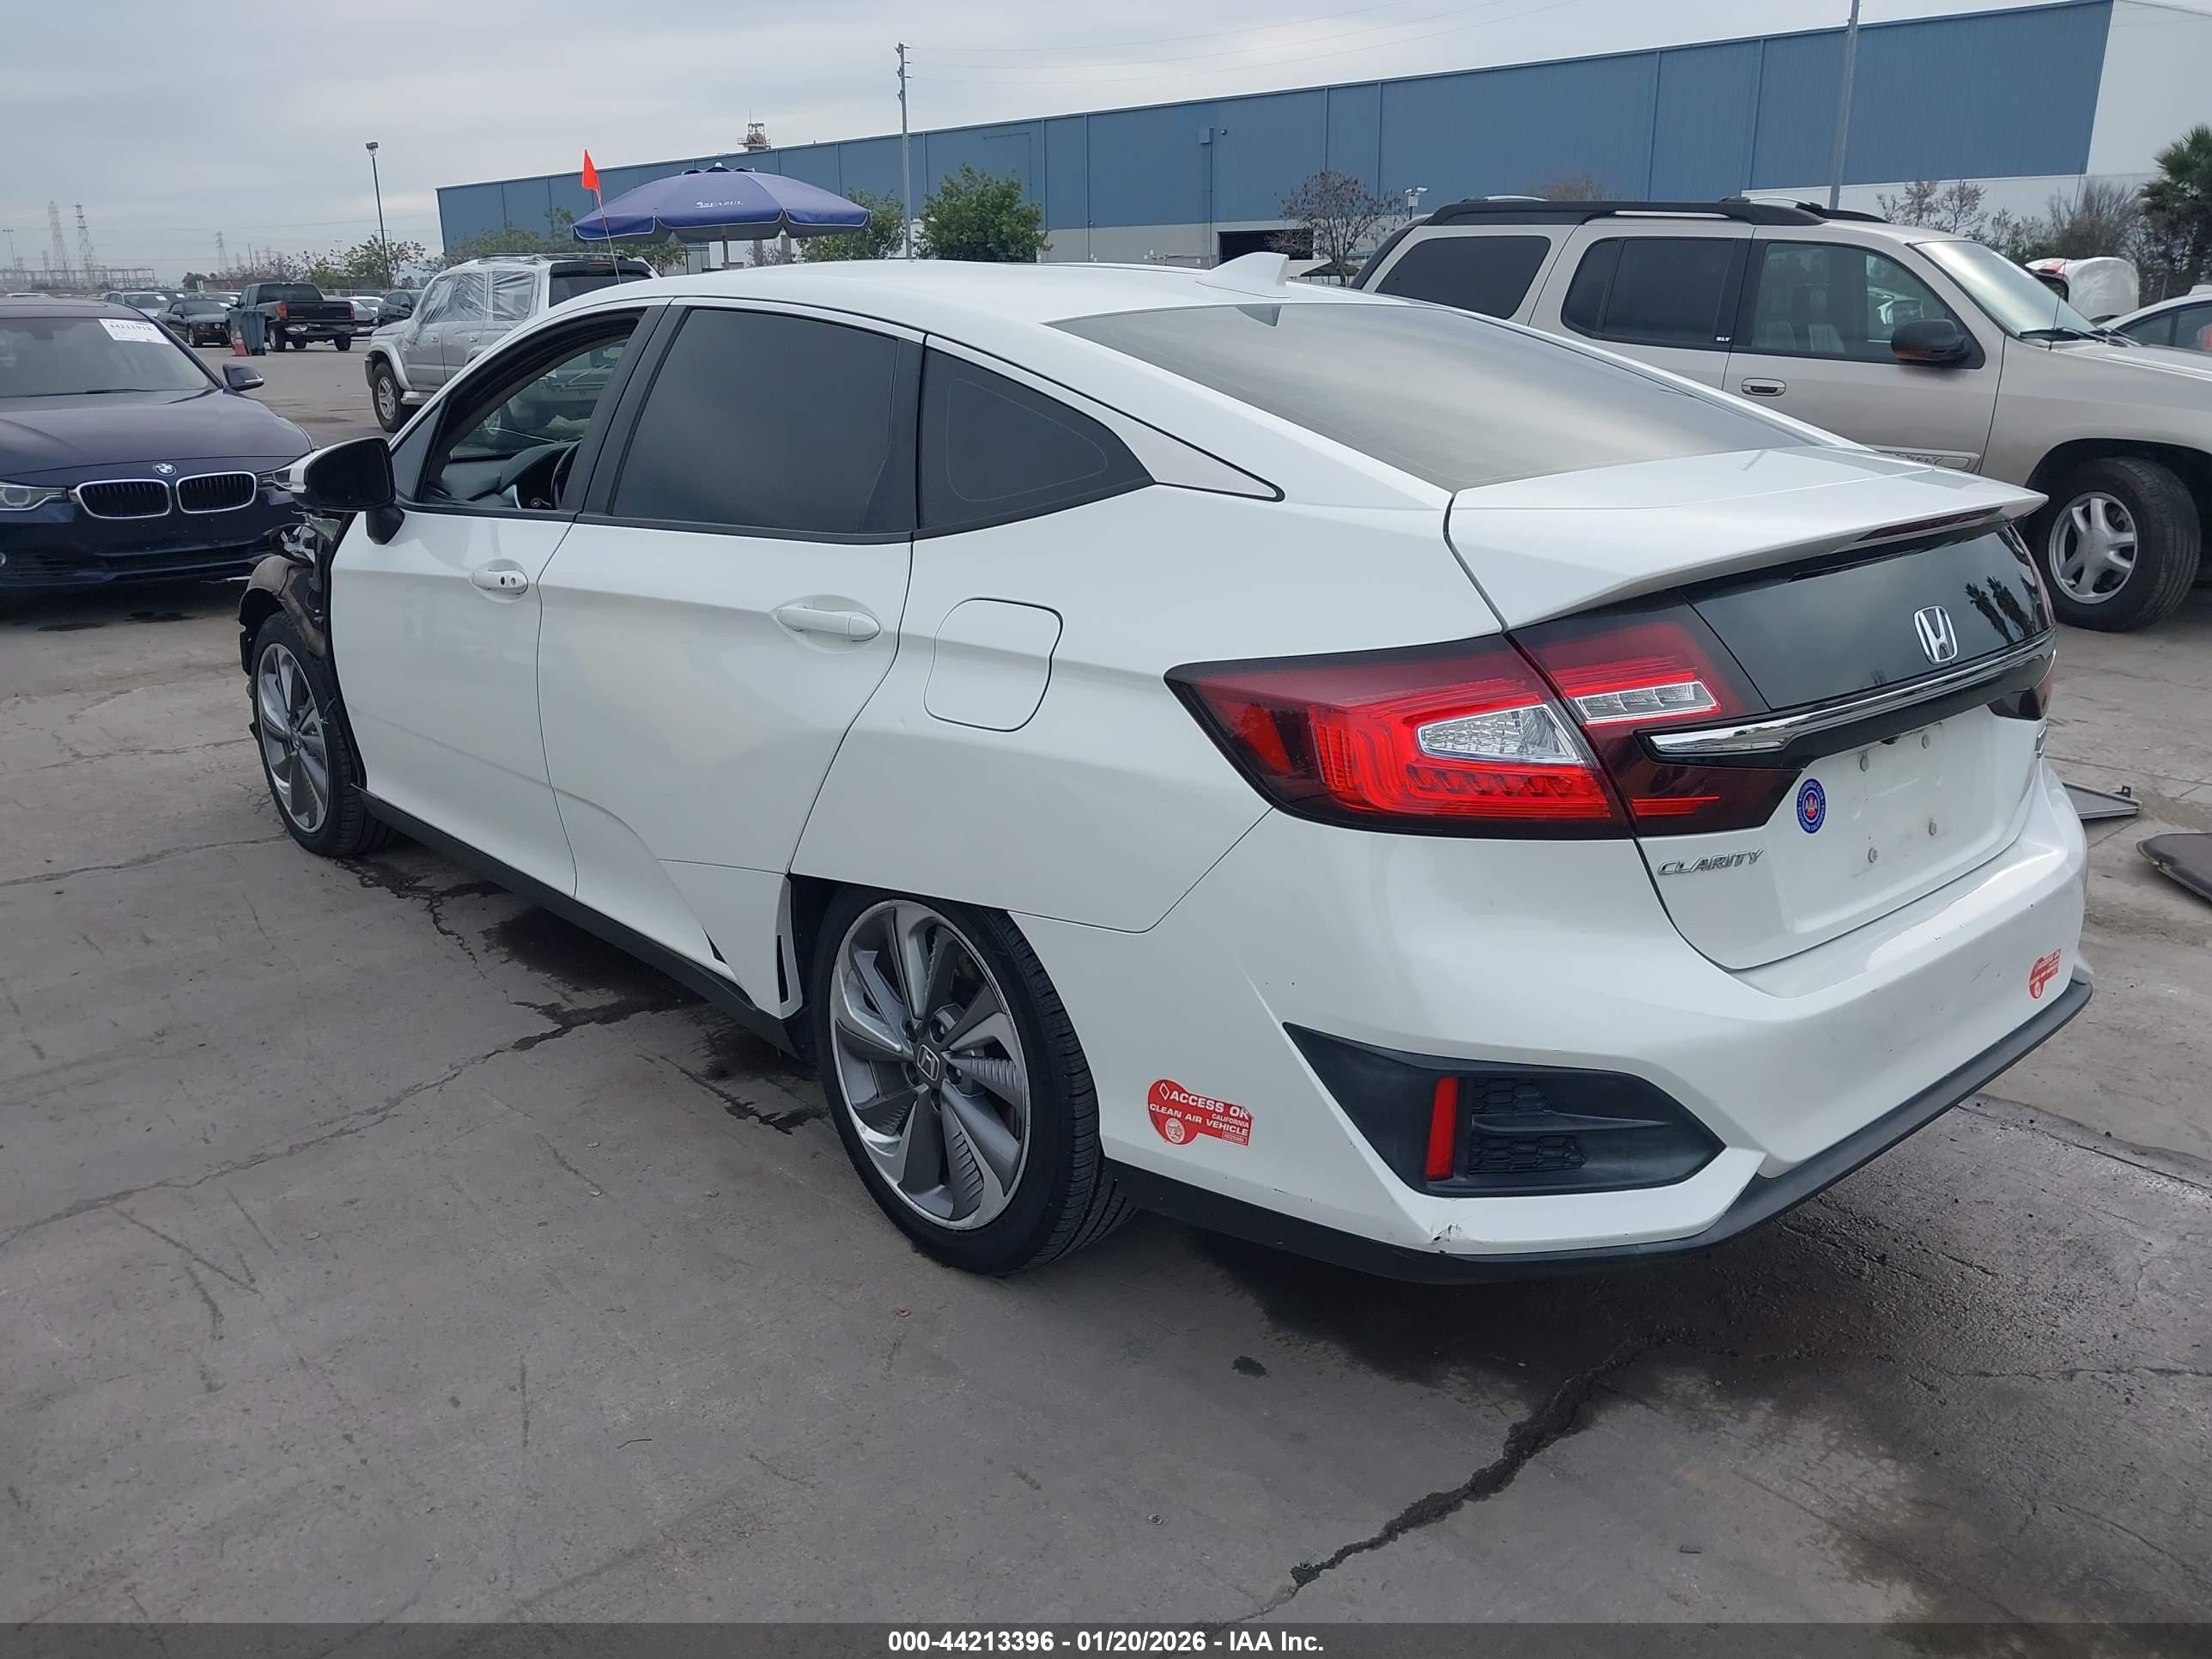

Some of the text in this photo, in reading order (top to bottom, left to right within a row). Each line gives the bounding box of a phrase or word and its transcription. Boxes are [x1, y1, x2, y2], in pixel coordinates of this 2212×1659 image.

[1658, 848, 1765, 875] CLARITY
[1170, 1091, 1224, 1113] ACCESS
[1150, 1103, 1249, 1136] CLEAN AIR VEHICLE
[1212, 1114, 1249, 1128] CALIFORNIA
